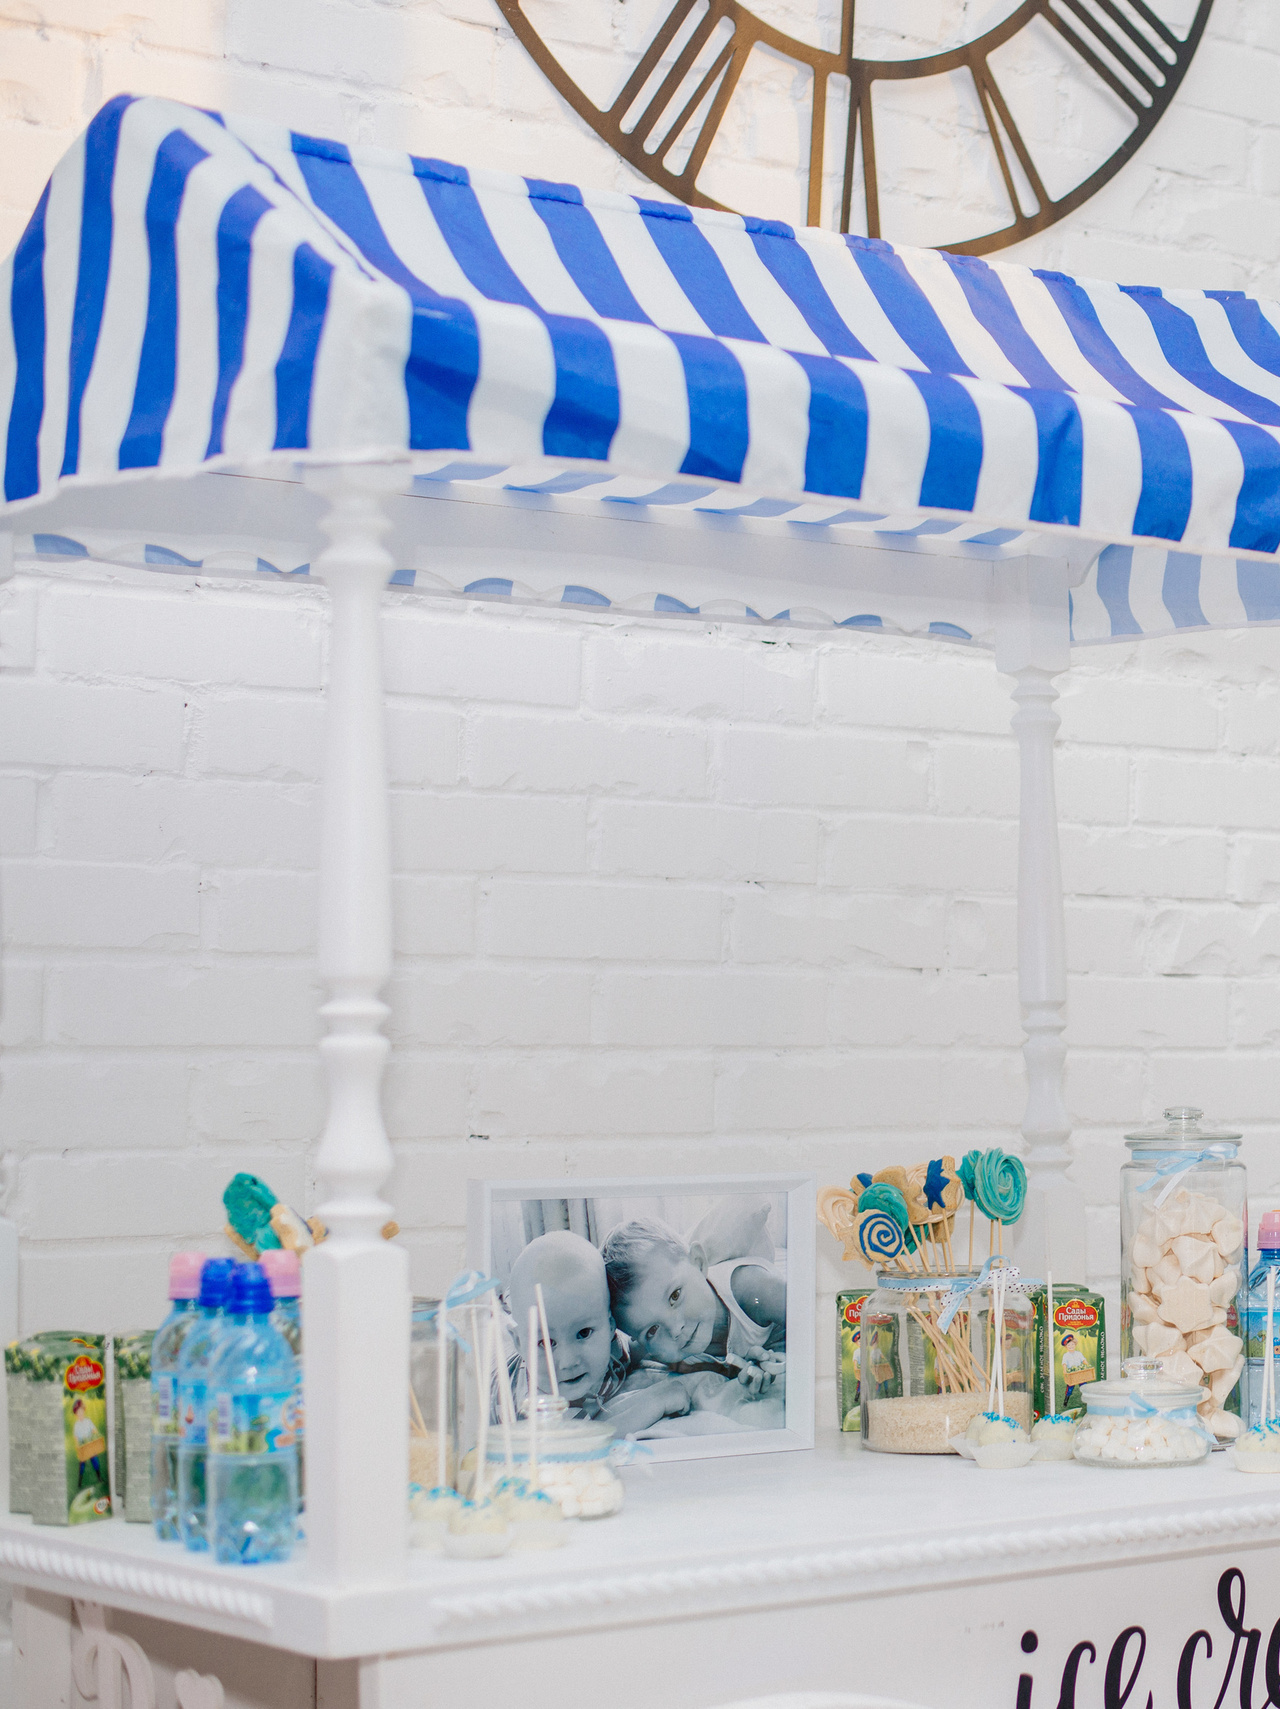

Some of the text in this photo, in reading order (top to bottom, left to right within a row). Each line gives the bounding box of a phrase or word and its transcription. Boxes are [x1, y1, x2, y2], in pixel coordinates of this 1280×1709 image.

[1065, 1306, 1087, 1315] Сады
[1058, 1313, 1095, 1322] Придонья
[1016, 1626, 1153, 1709] ice
